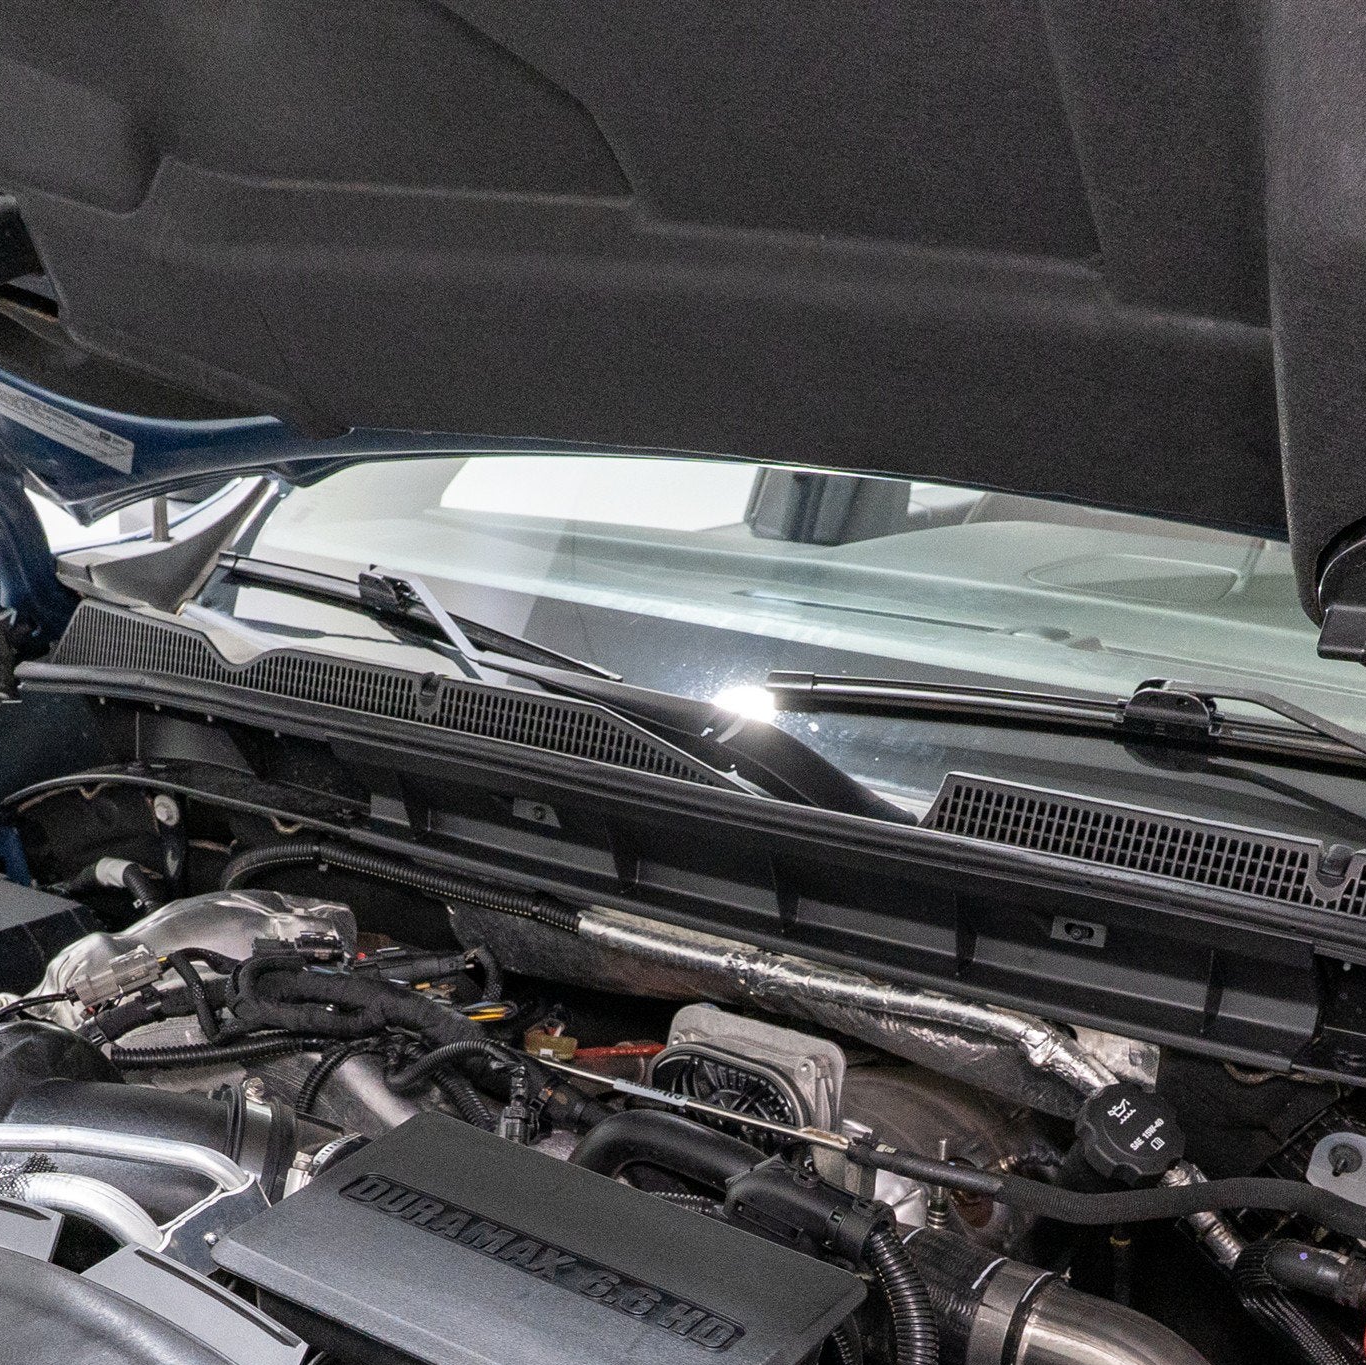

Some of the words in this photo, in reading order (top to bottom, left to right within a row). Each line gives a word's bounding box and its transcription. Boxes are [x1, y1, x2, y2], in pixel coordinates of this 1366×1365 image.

[1129, 1136, 1145, 1151] SAE
[1141, 1117, 1165, 1139] 15W-40
[344, 1177, 577, 1280] DURAMAX
[579, 1270, 662, 1317] 6.6
[657, 1302, 736, 1350] HD
